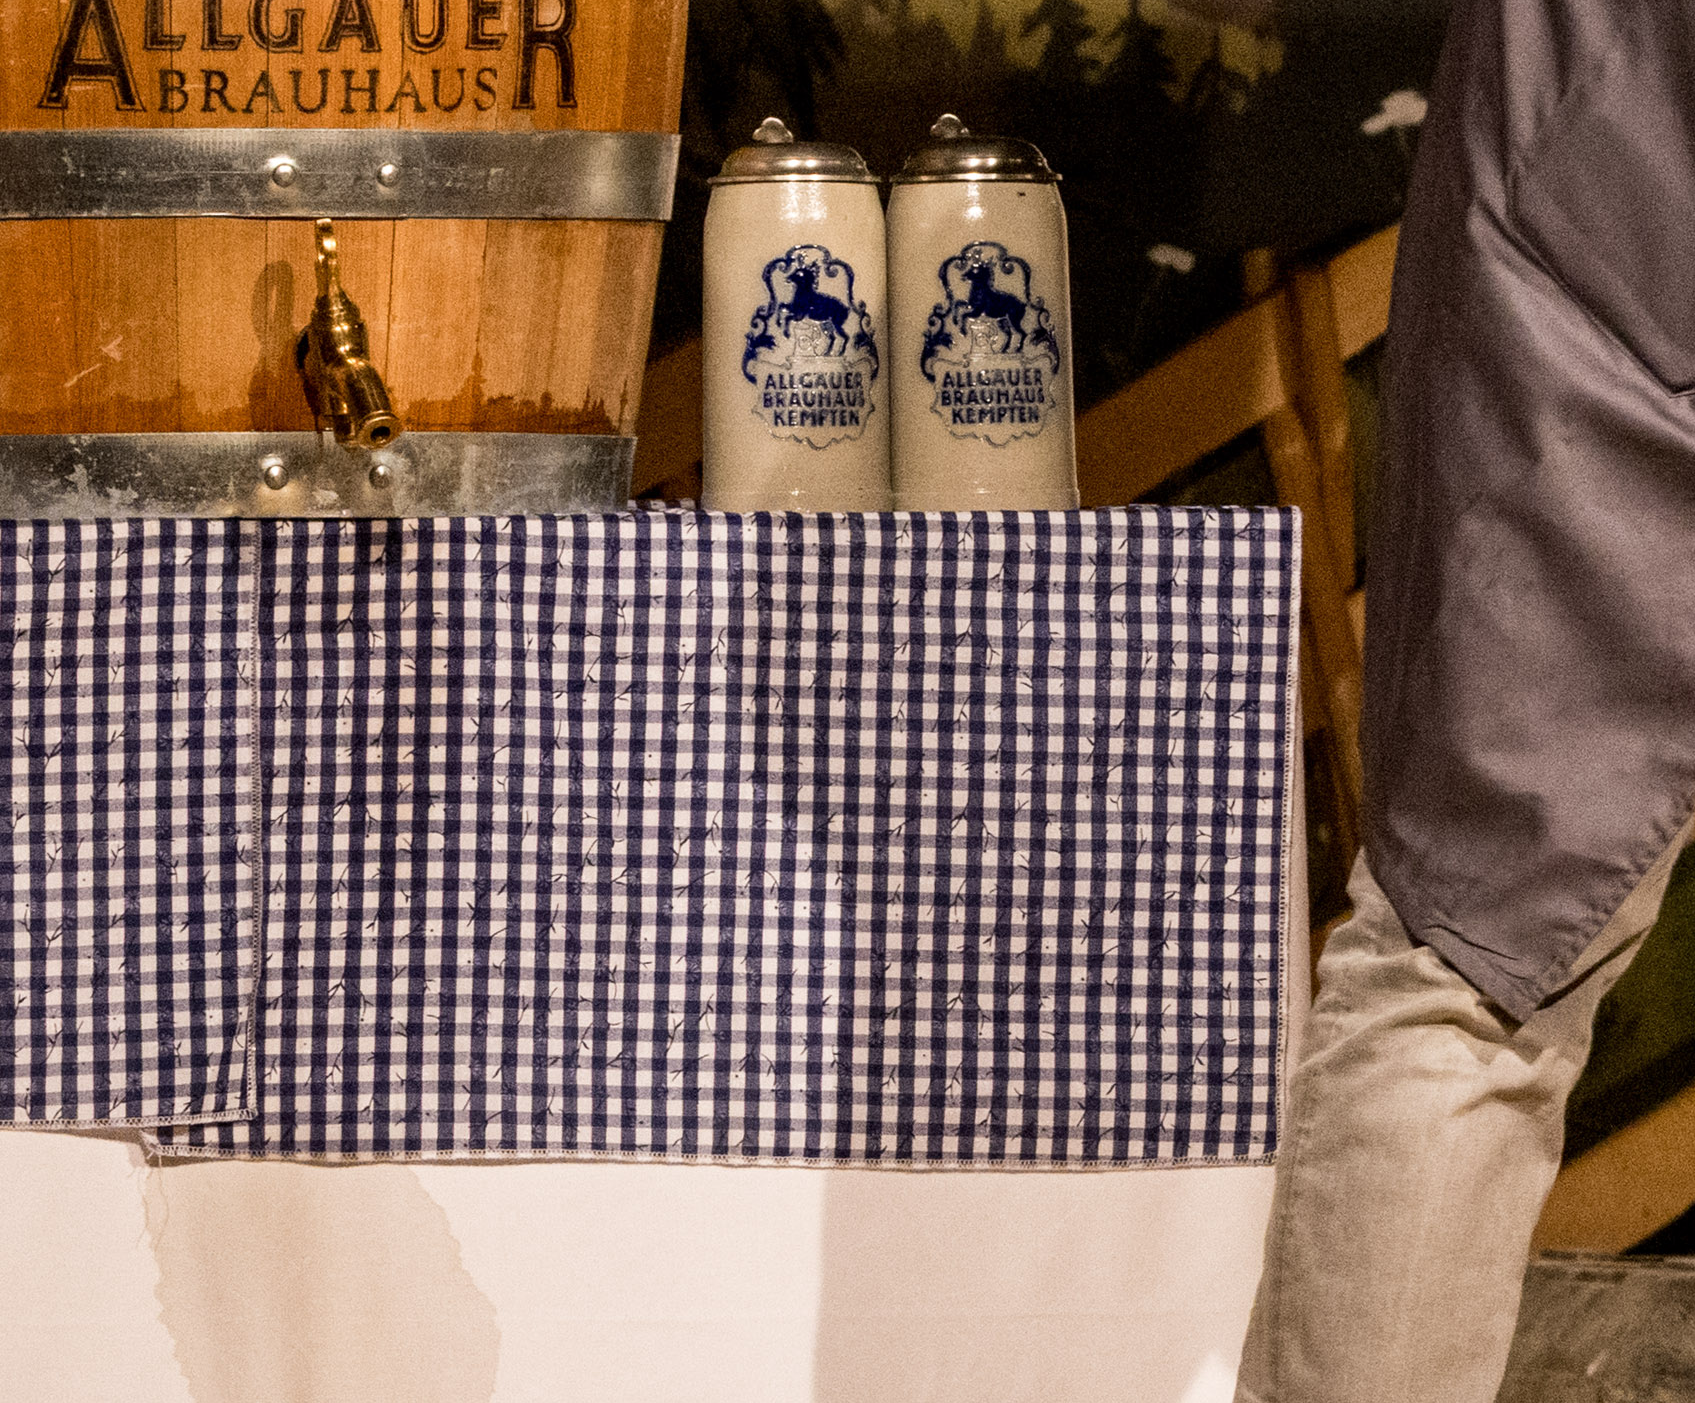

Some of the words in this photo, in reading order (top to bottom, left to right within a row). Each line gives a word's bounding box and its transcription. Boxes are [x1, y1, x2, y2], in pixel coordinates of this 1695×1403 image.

[157, 67, 499, 114] BRAUHAUS
[764, 370, 864, 390] ALLGÄUER
[942, 368, 1044, 389] ALLGÄUER
[762, 390, 866, 409] BRAUHAUS
[940, 389, 1045, 407] BRAUHAUS
[773, 409, 861, 428] KEMPTEN
[950, 406, 1040, 426] KEMPTEN
